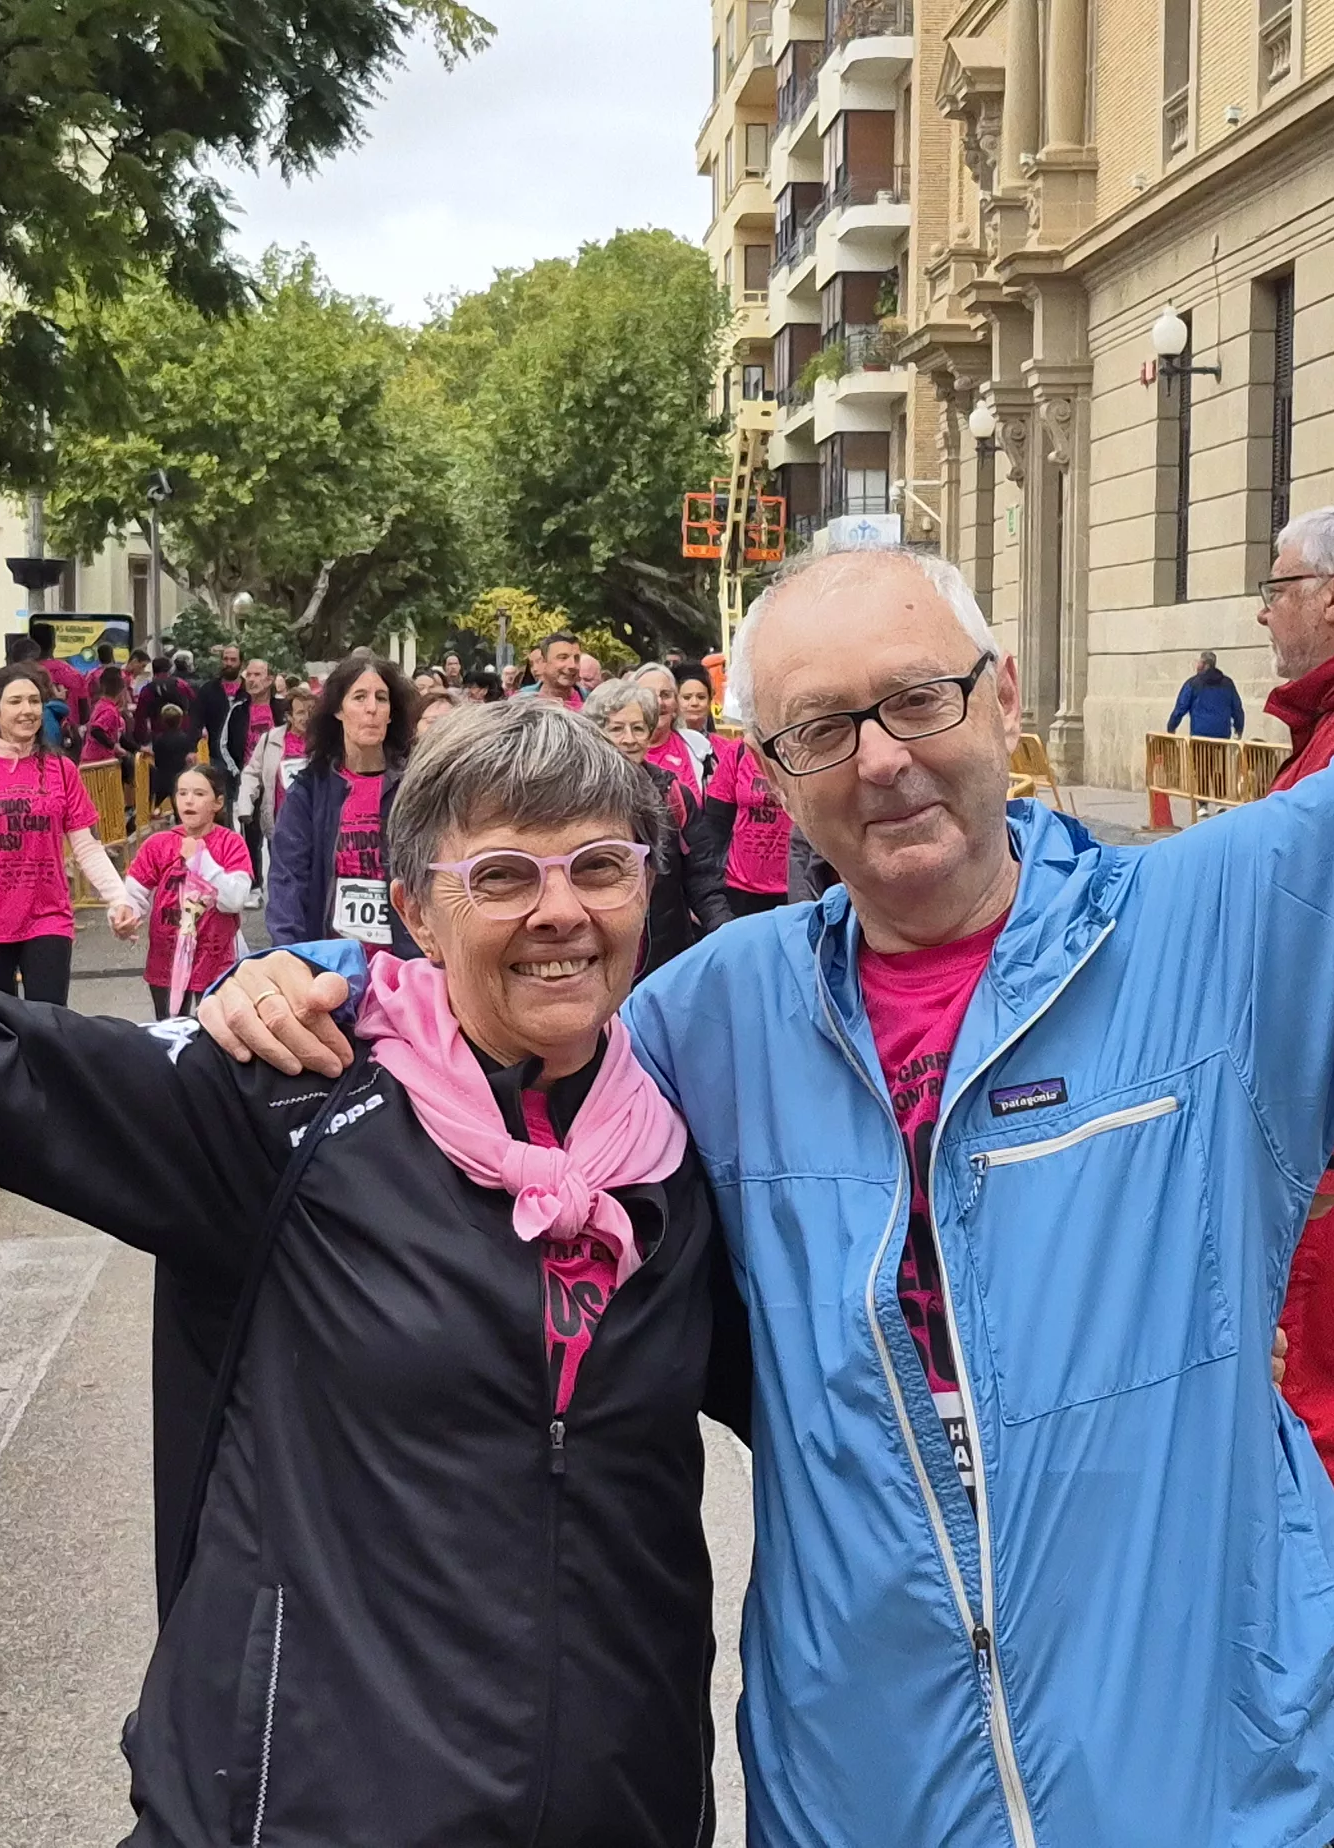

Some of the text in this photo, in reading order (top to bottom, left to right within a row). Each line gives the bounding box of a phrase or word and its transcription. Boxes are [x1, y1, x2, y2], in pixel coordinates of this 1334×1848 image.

[897, 1050, 950, 1083] CARR
[1000, 1091, 1058, 1112] patagonia
[288, 1094, 385, 1148] Kppa
